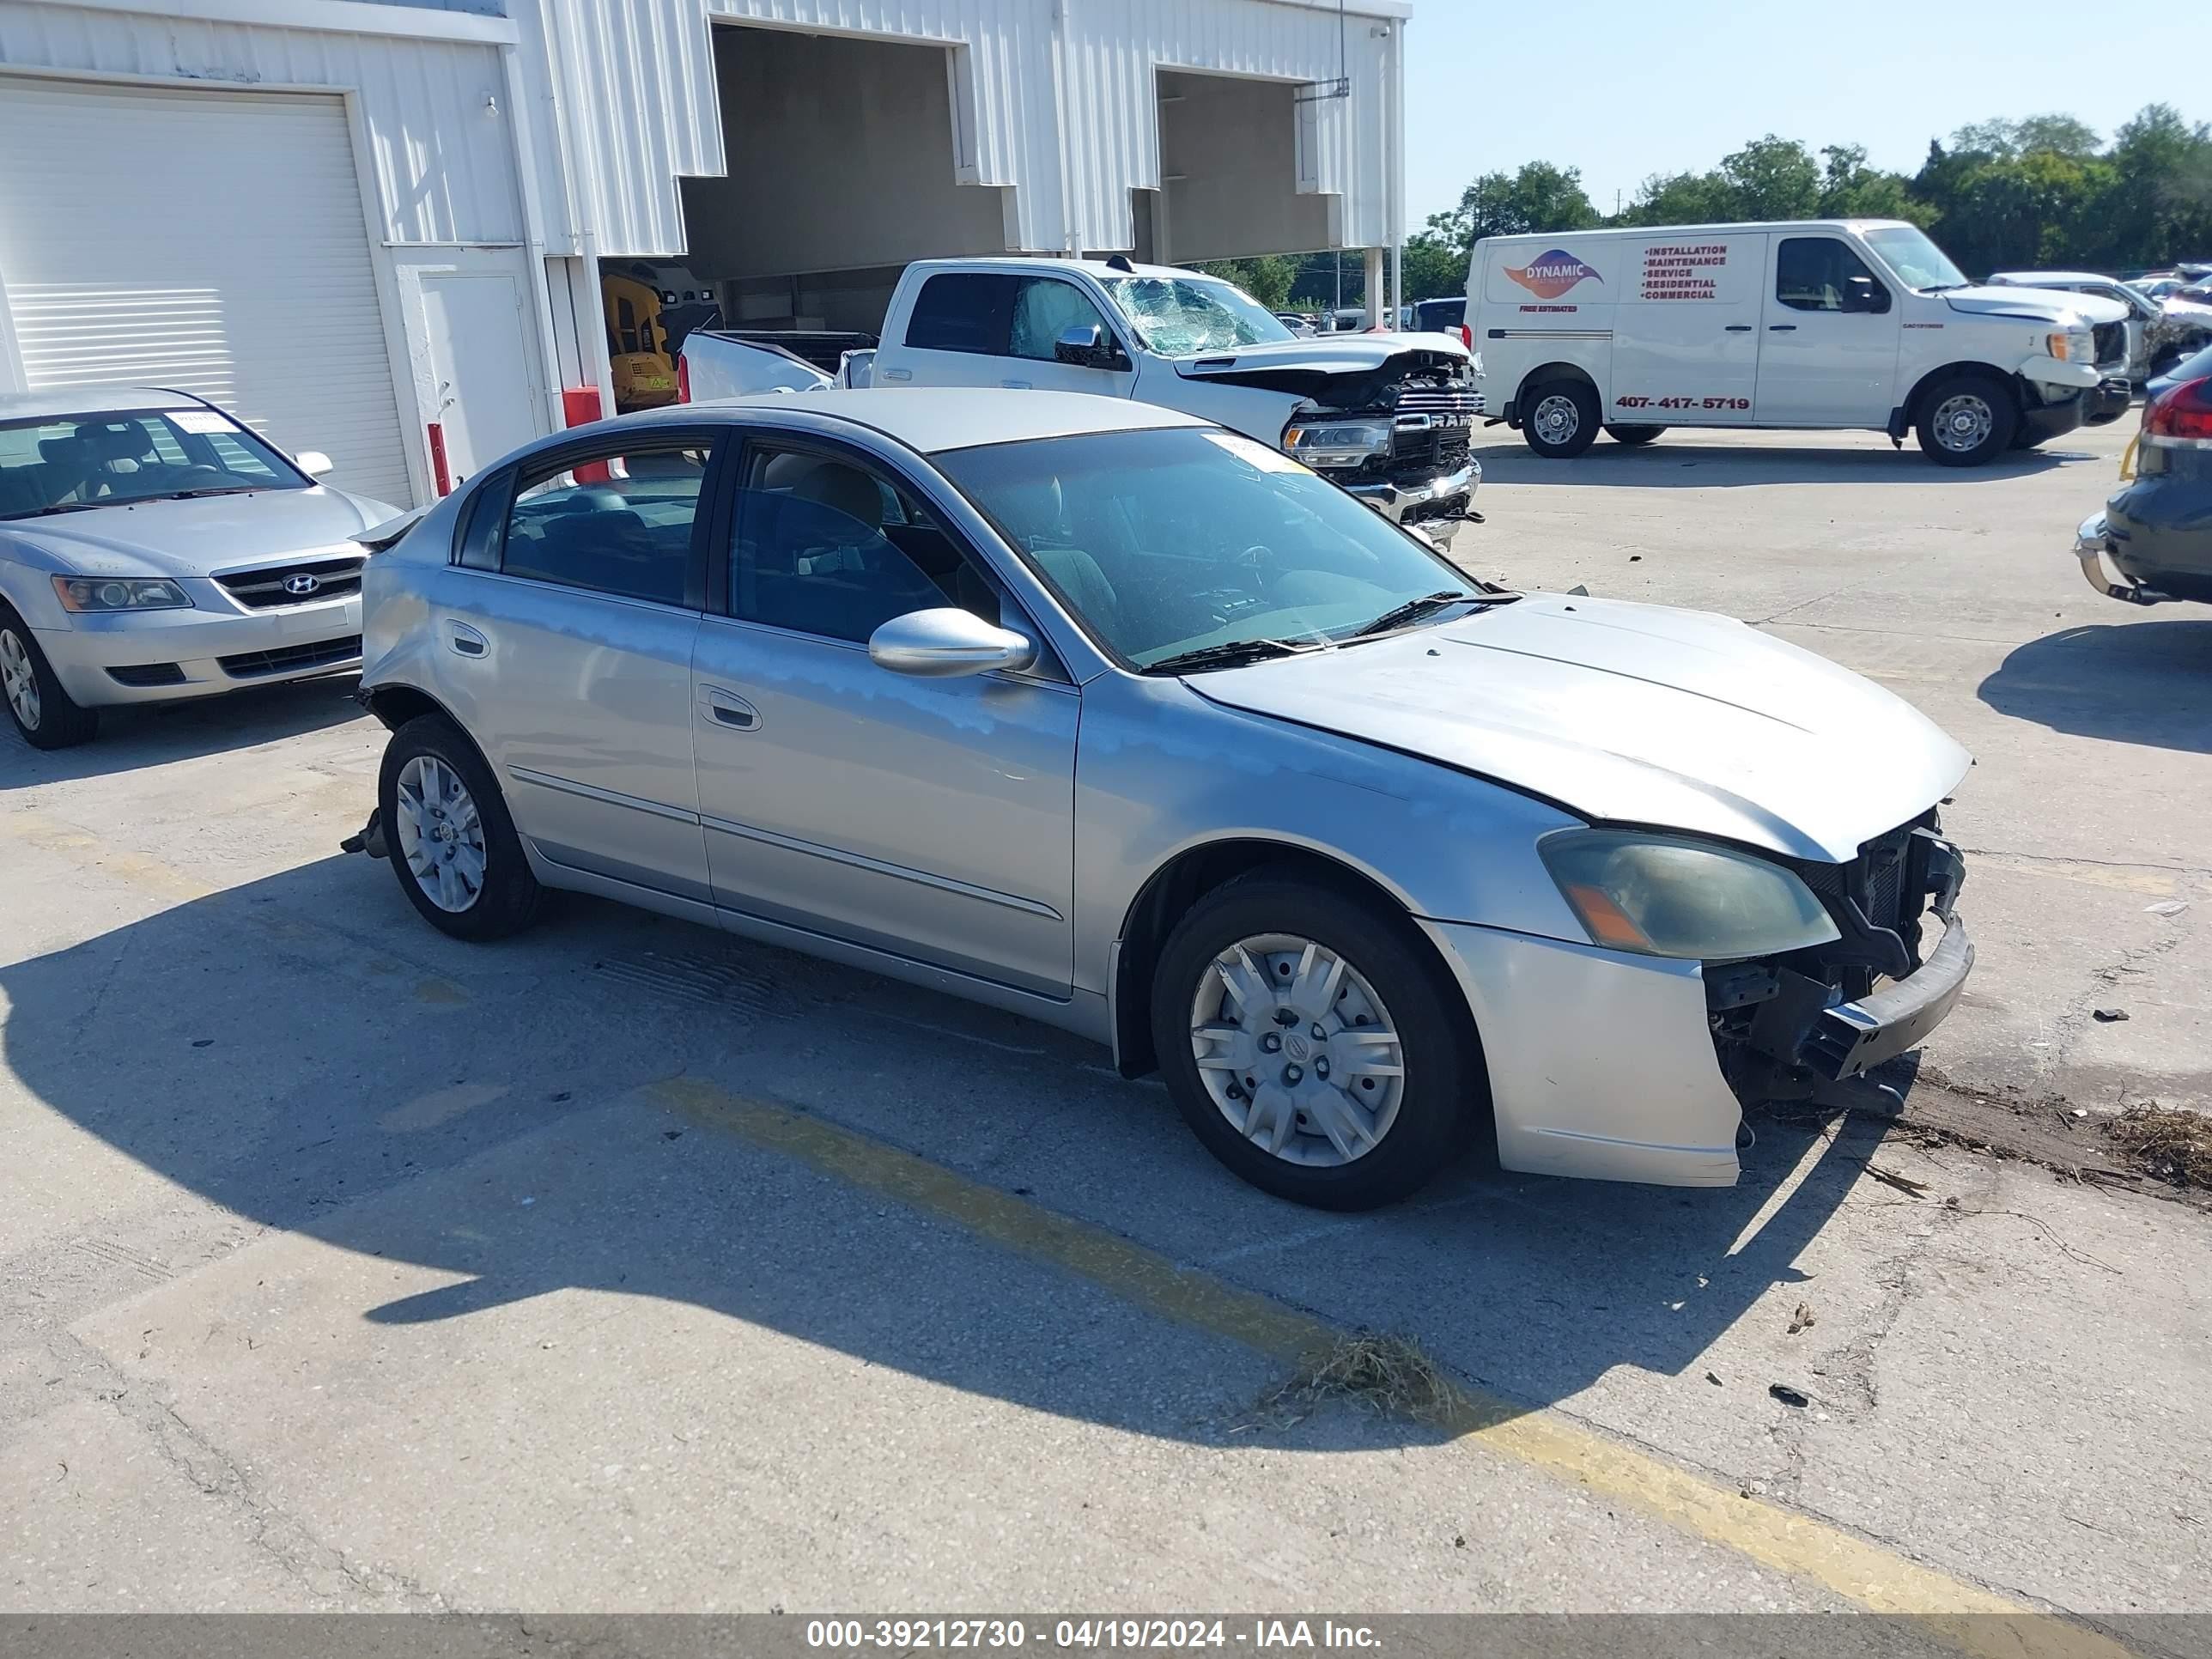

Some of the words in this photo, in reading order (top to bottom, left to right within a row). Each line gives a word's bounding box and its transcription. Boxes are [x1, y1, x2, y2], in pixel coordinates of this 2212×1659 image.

[1526, 264, 1584, 279] DYNAMIC
[1647, 269, 1692, 277] SERVICE
[1430, 415, 1473, 428] RAM
